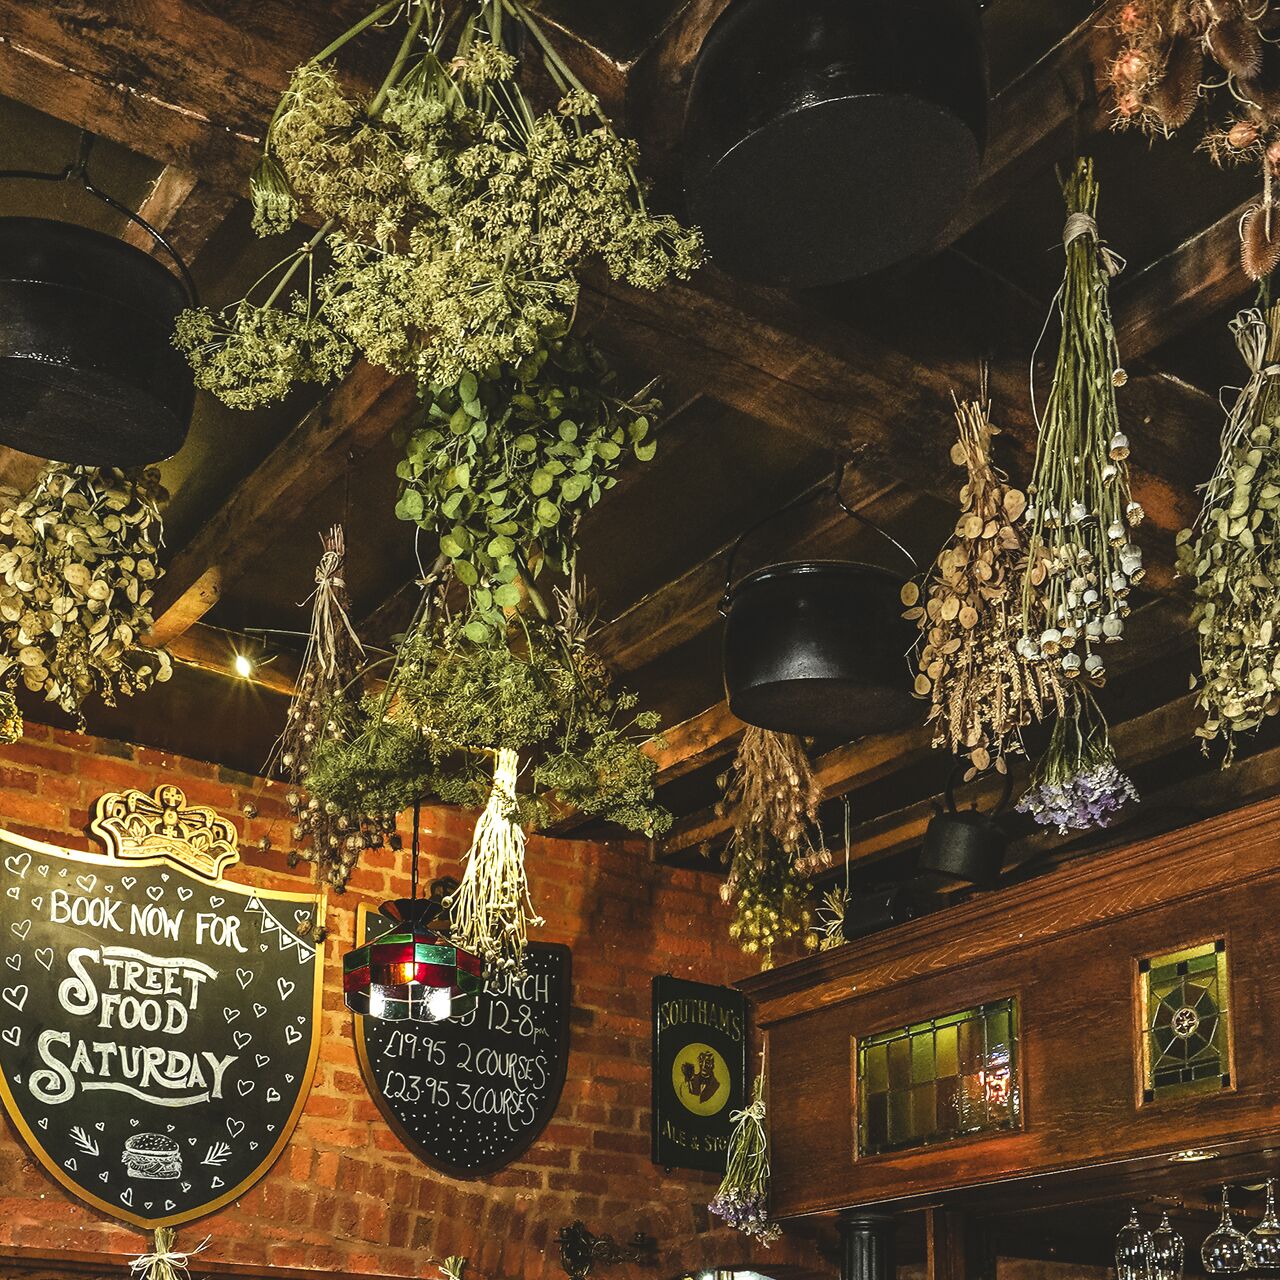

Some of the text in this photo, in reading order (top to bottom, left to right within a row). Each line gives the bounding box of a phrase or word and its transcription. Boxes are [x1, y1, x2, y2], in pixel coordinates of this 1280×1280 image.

[50, 889, 248, 953] BOOK NOW FOR
[58, 945, 219, 1015] STREET
[483, 972, 549, 1003] LUNCH
[99, 993, 188, 1034] FOOD
[660, 999, 741, 1042] SOUTHAM'S
[28, 1030, 238, 1105] SATURDAY
[457, 1043, 472, 1072] 2
[475, 1048, 548, 1092] COURSES
[456, 1083, 471, 1109] 3
[473, 1087, 538, 1131] COURSES
[662, 1121, 686, 1147] ALE
